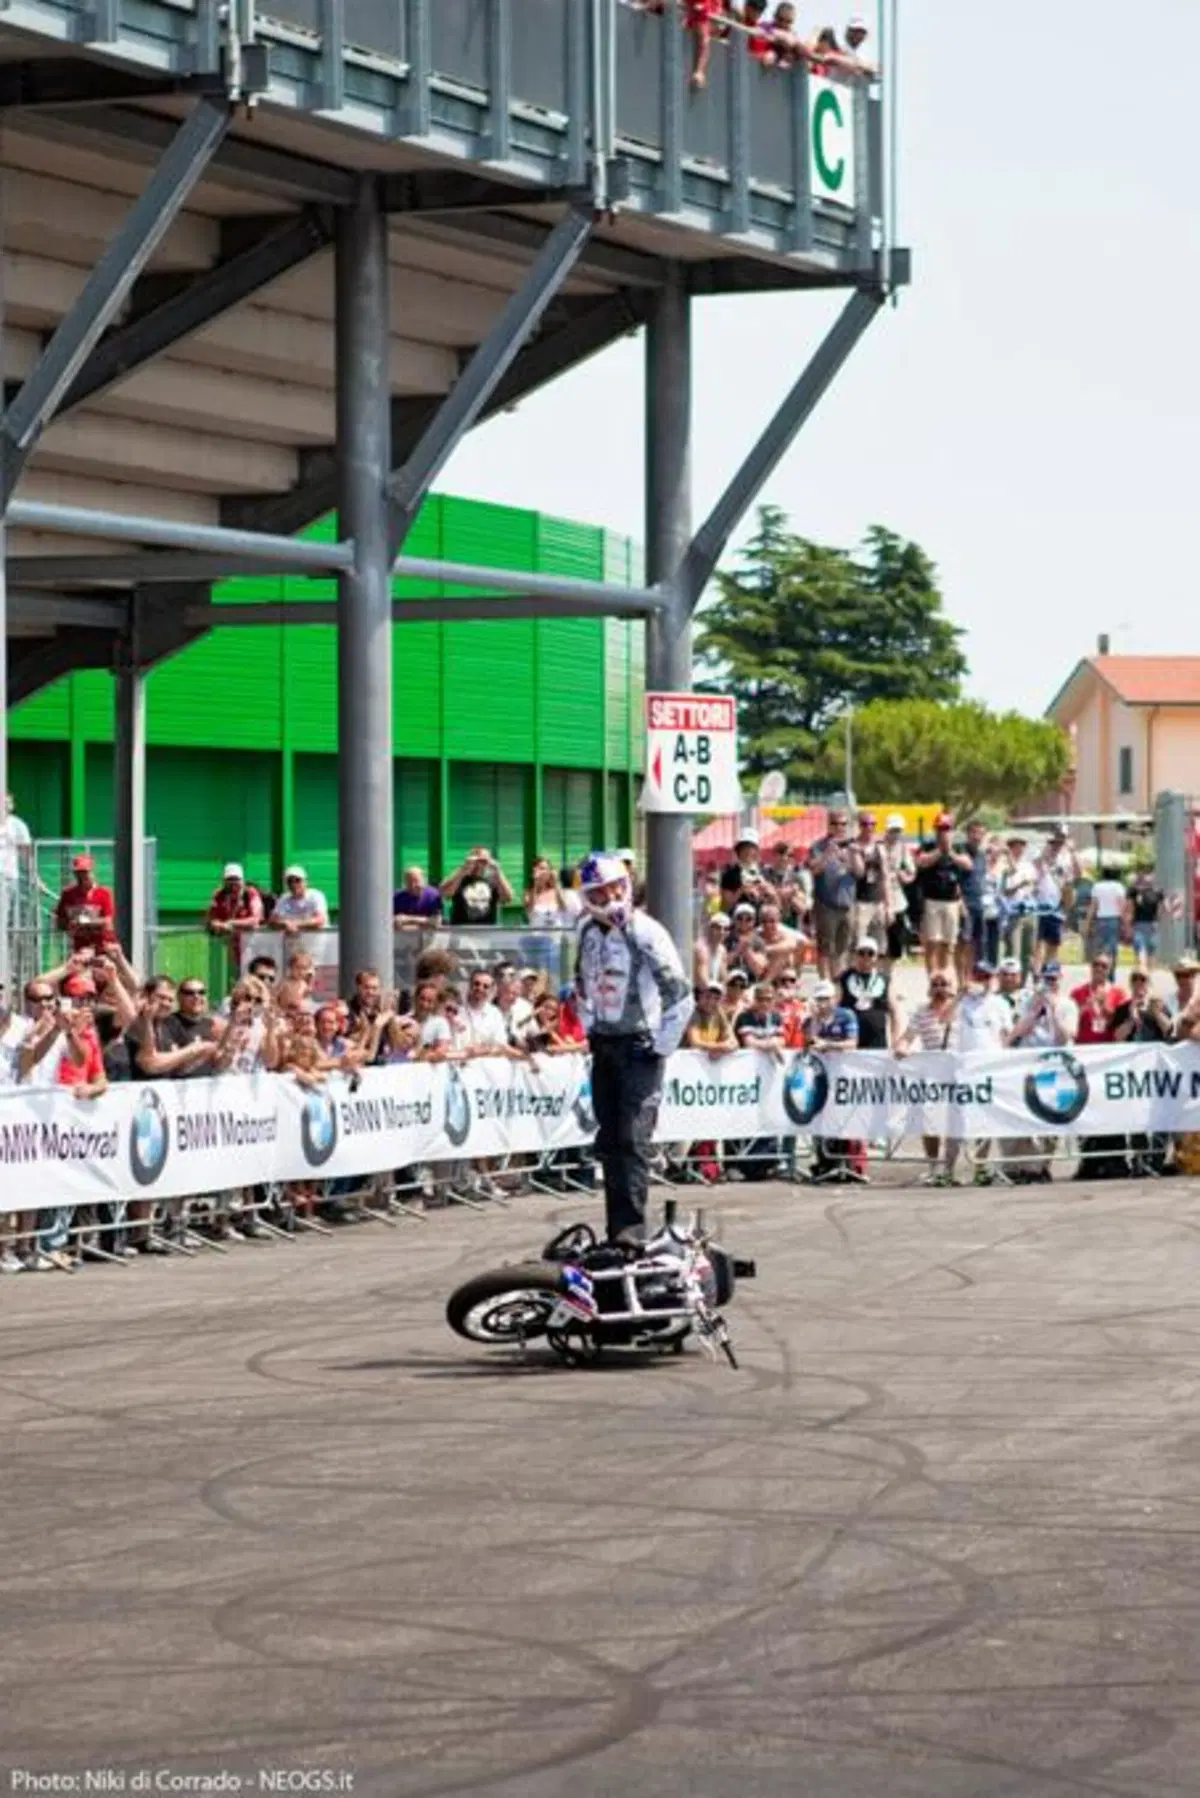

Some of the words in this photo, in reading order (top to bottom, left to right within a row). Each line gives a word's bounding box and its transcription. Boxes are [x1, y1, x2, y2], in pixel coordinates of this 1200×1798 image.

[813, 88, 845, 191] C
[673, 733, 711, 765] A-B
[673, 773, 711, 804] C-D
[835, 1077, 886, 1105] BMW
[889, 1076, 993, 1103] Motorrad
[1105, 1070, 1182, 1100] BMW
[0, 1123, 37, 1164] MW
[41, 1122, 118, 1160] Motorrad
[177, 1112, 217, 1151] BMW
